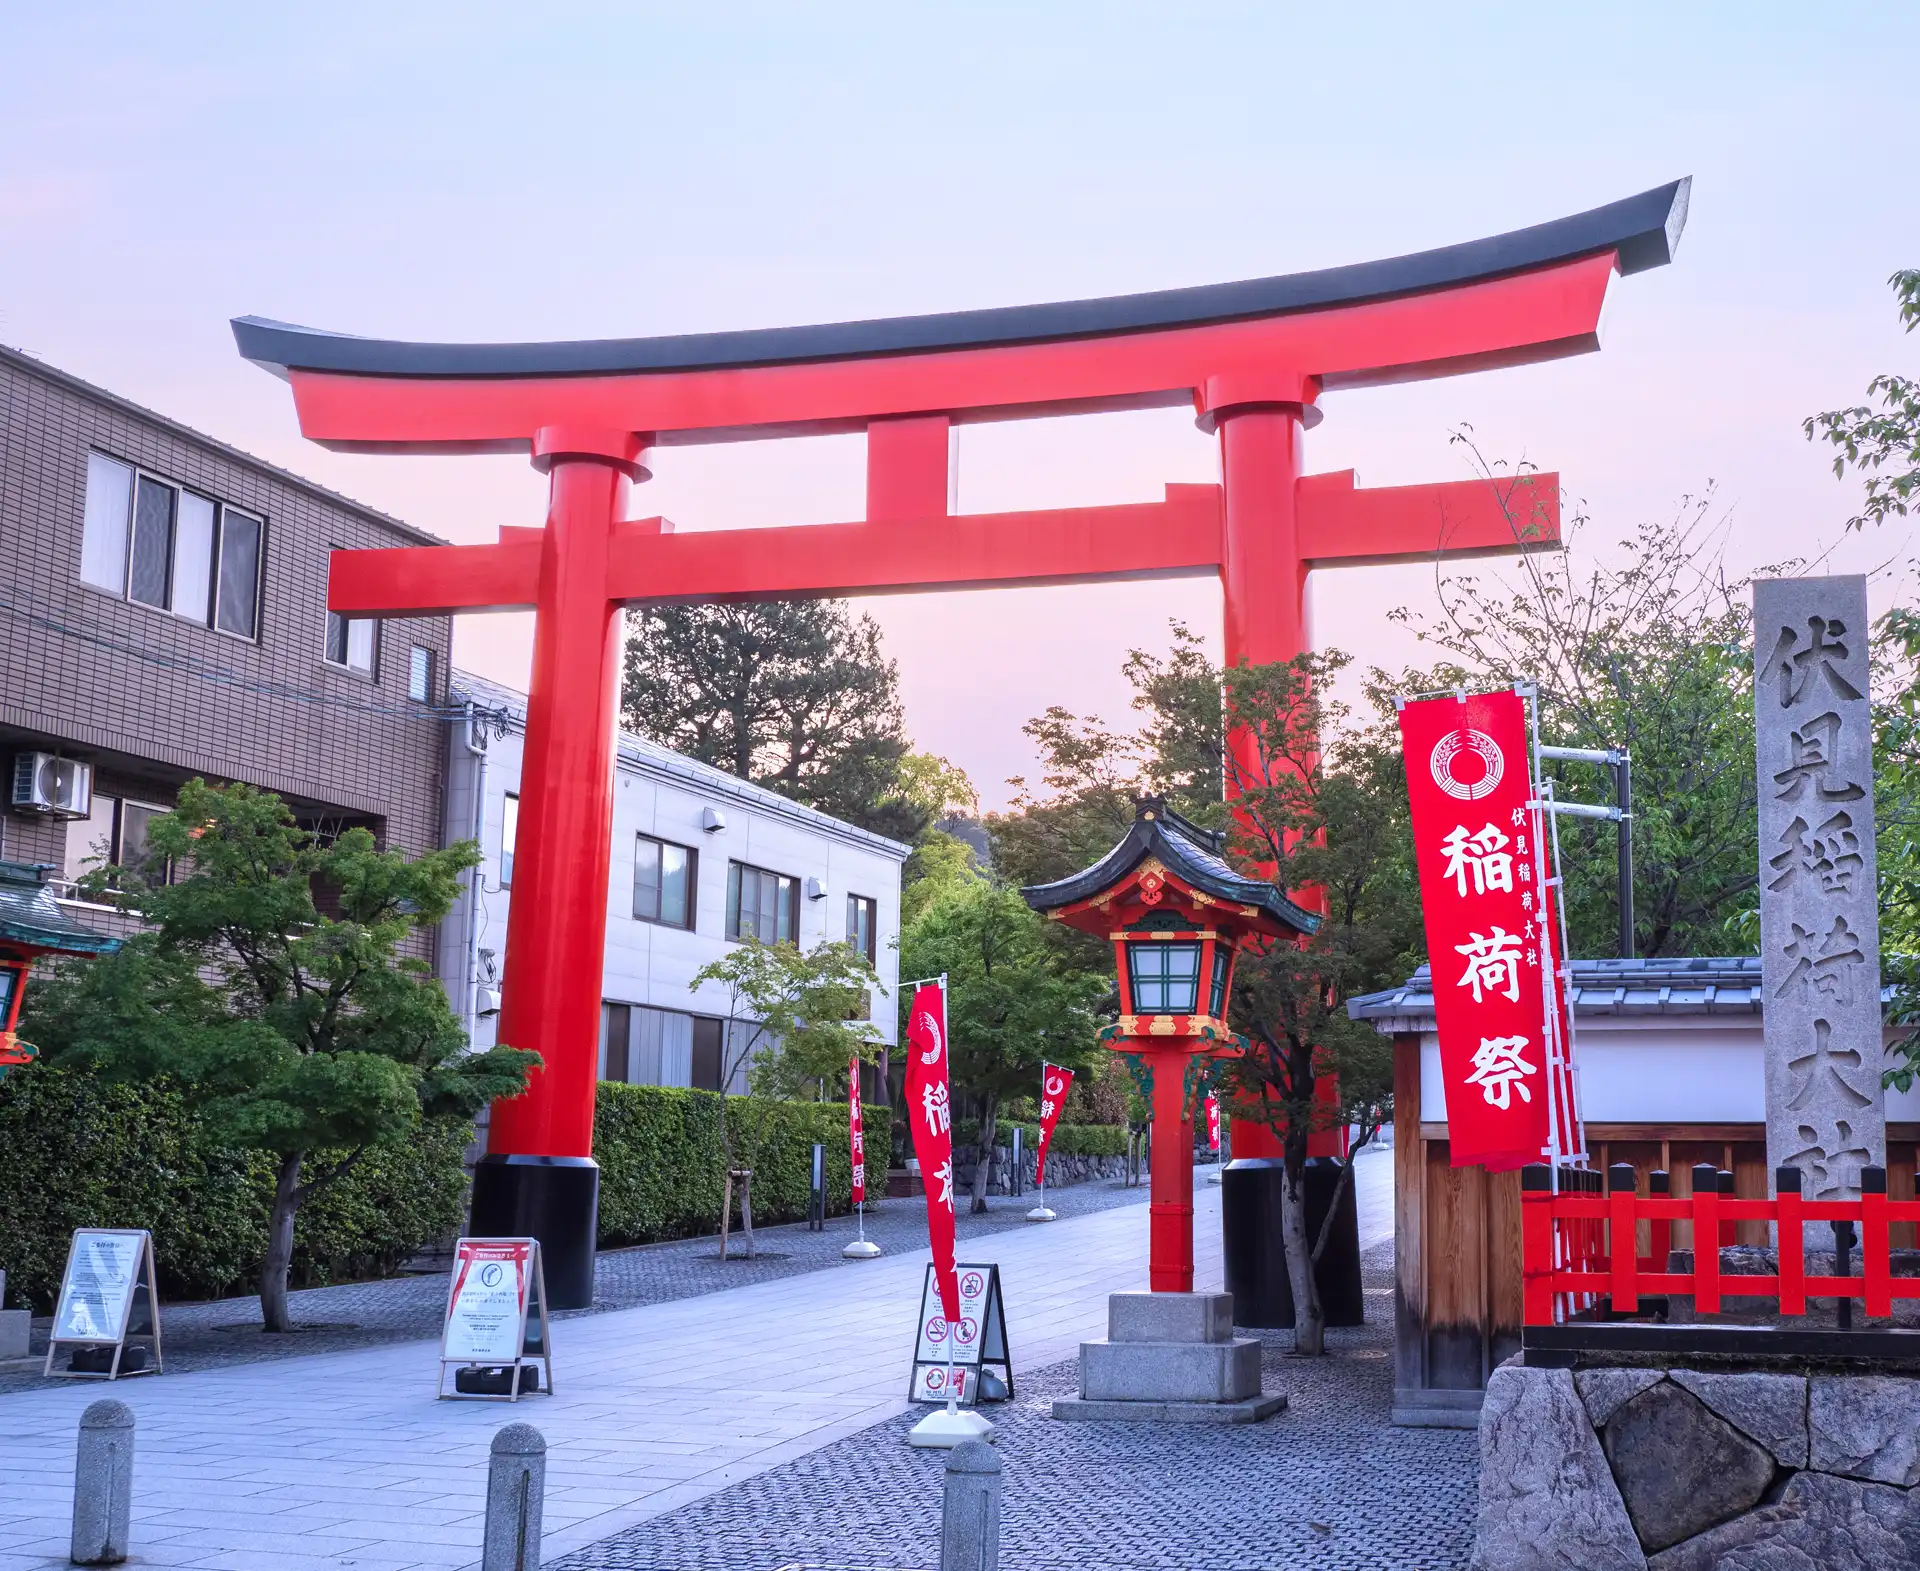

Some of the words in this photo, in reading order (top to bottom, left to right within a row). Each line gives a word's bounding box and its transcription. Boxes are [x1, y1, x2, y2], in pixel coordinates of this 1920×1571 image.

[1440, 821, 1537, 1111] 稲荷祭
[1511, 807, 1538, 967] 伏見稲荷大社
